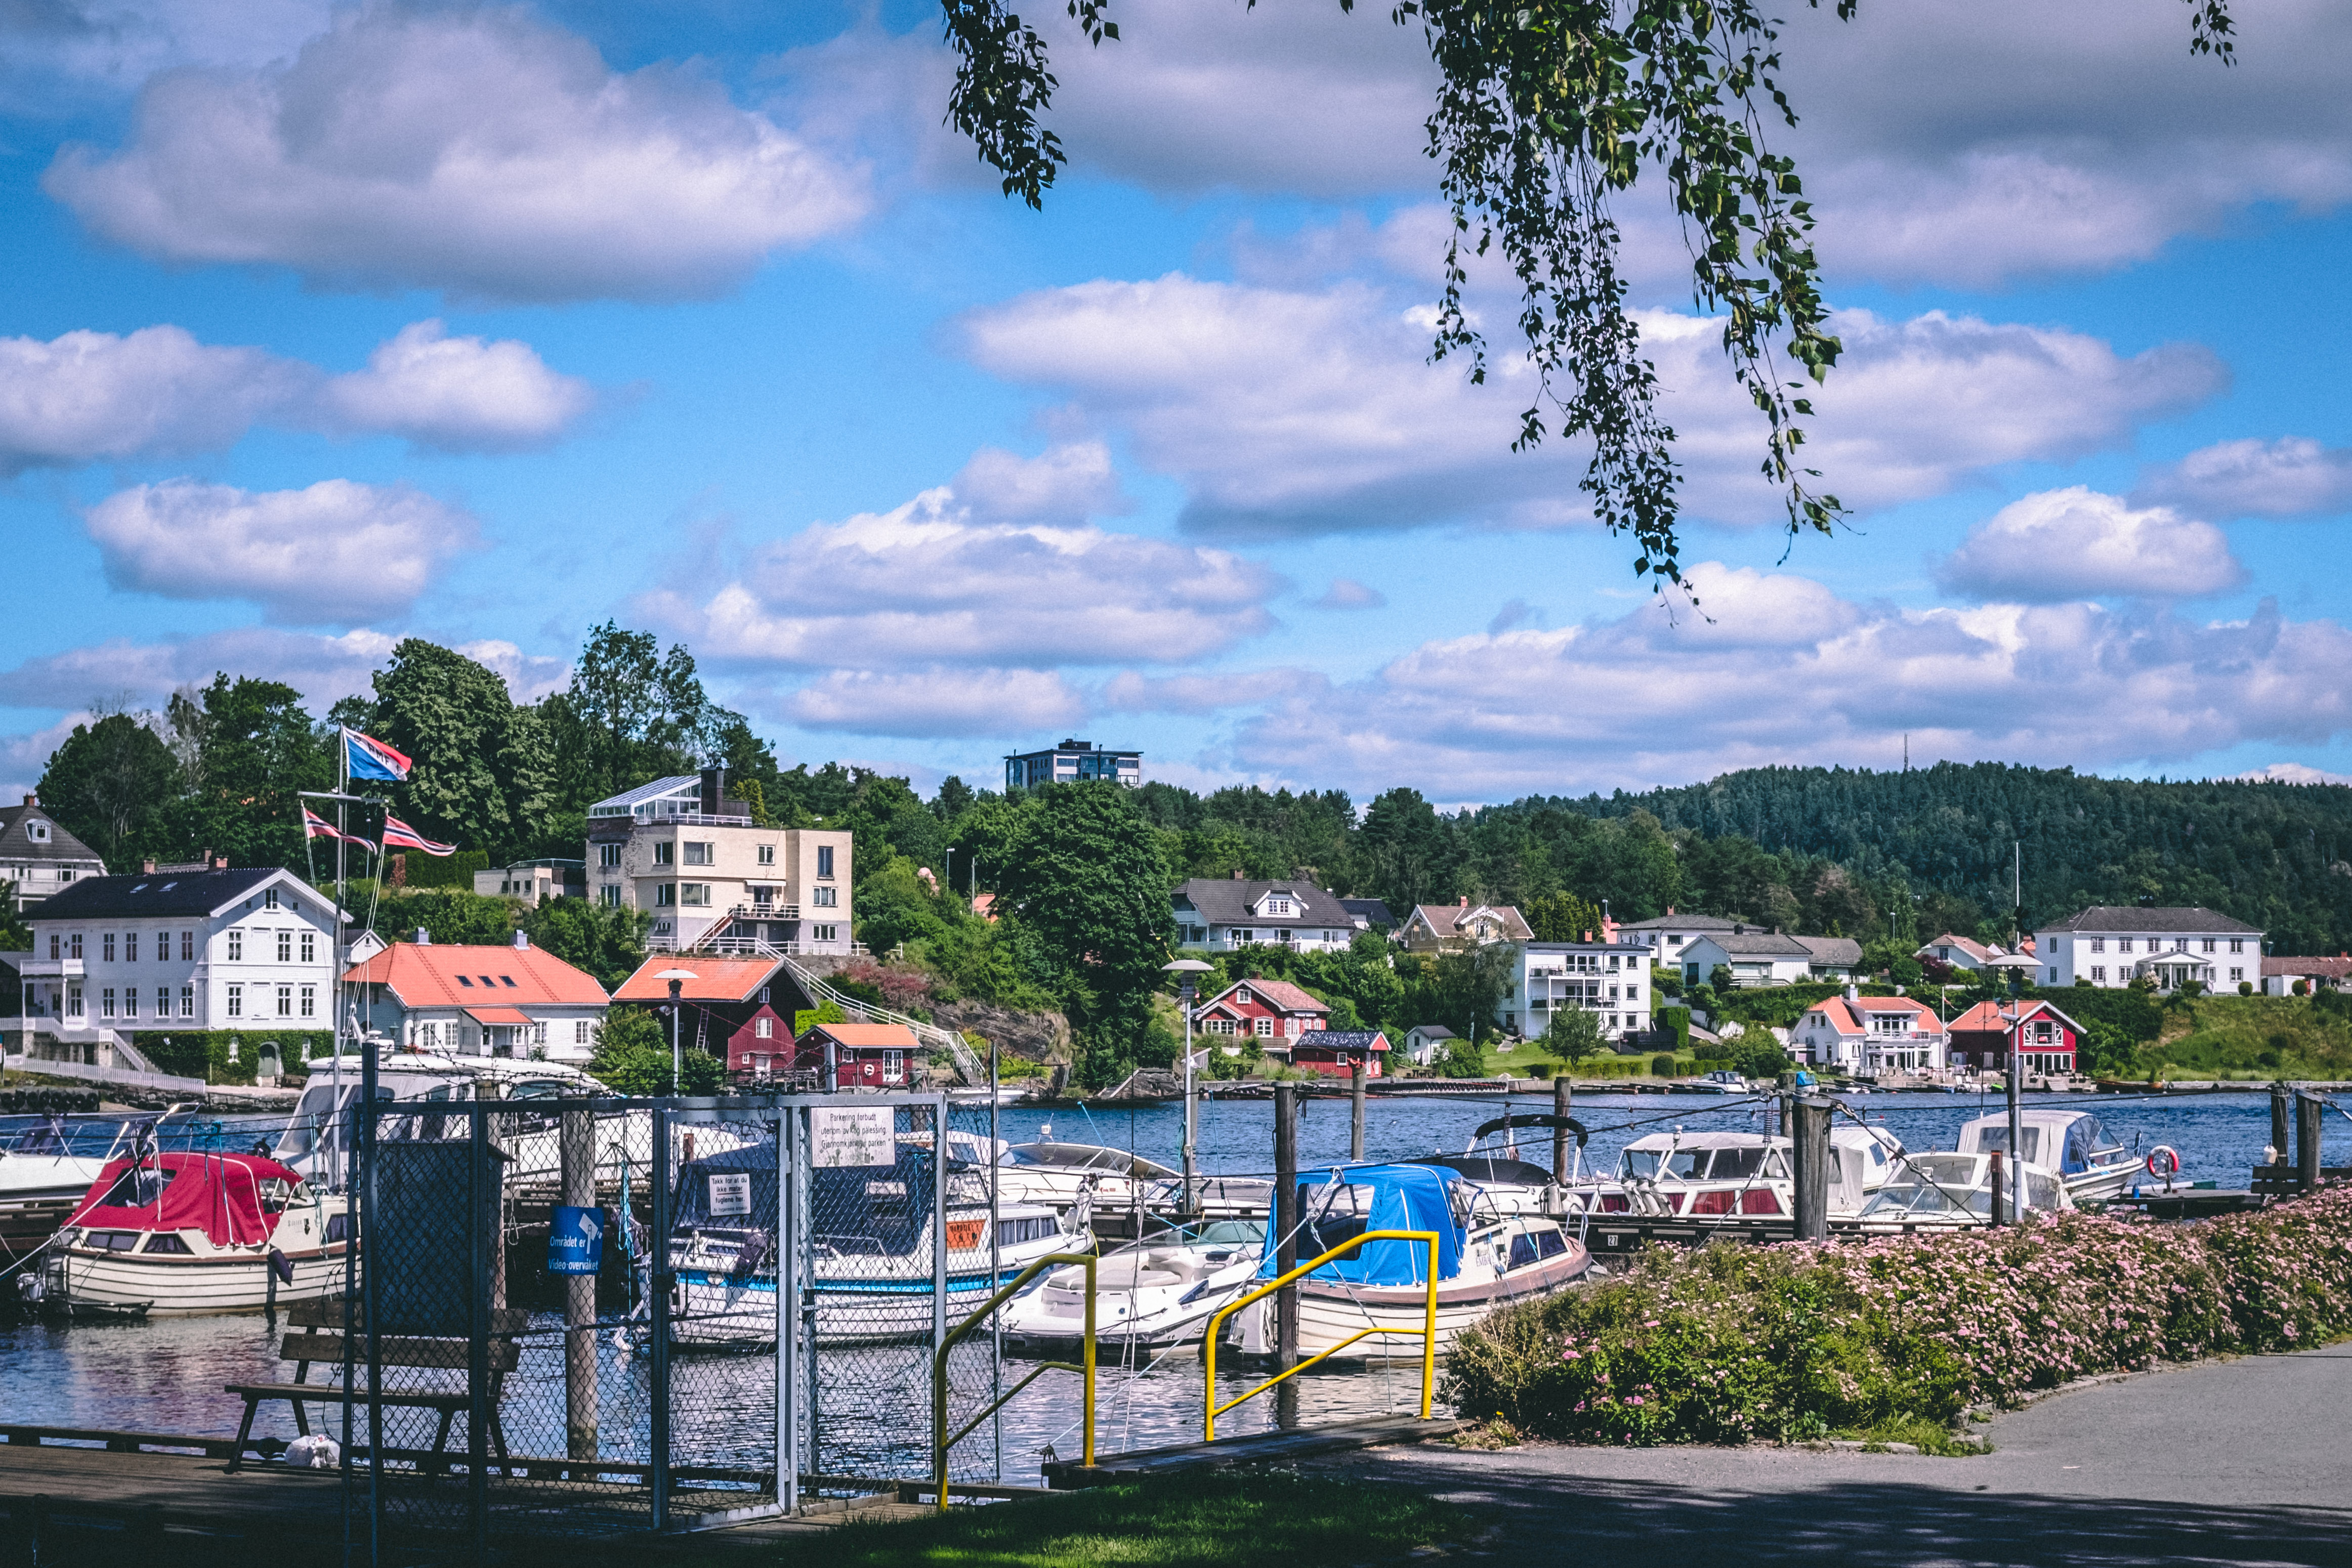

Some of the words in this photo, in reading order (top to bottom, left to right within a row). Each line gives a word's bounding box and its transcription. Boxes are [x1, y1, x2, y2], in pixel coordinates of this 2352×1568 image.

[830, 1113, 855, 1122] Parkering
[857, 1113, 876, 1121] forbudt
[821, 1127, 841, 1135] utenom
[868, 1138, 886, 1148] parken
[550, 1235, 577, 1247] Området
[1609, 1236, 1617, 1245] 27
